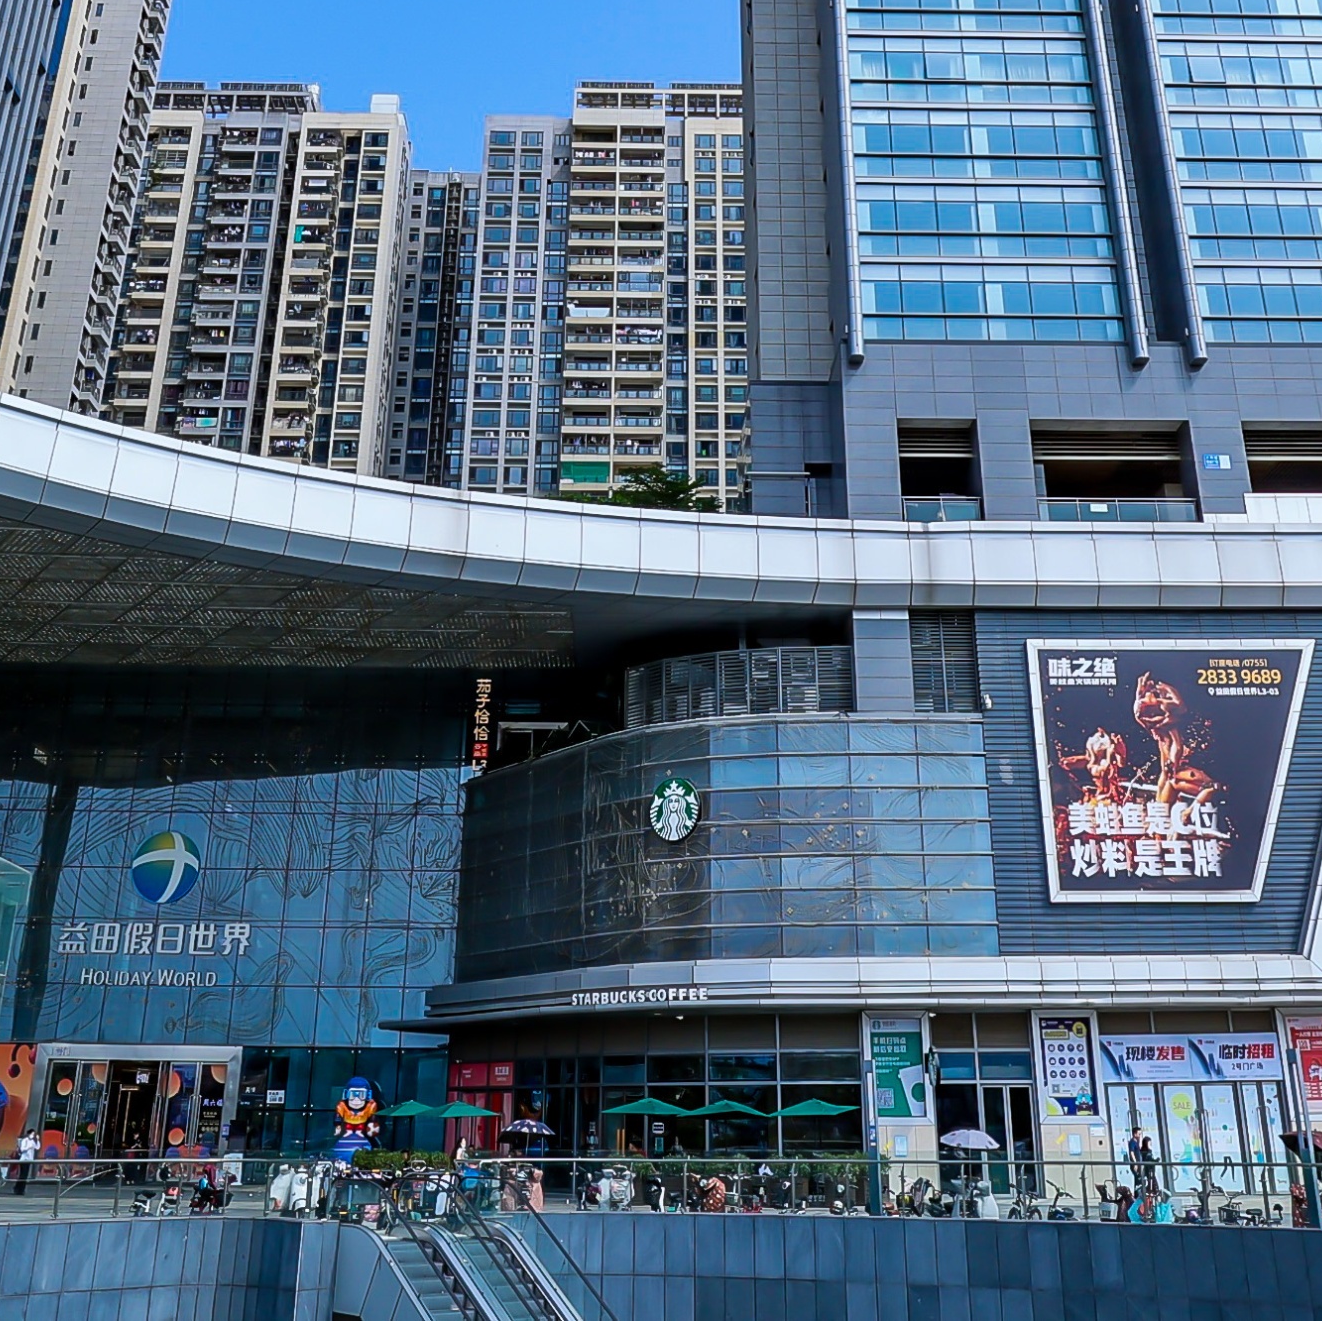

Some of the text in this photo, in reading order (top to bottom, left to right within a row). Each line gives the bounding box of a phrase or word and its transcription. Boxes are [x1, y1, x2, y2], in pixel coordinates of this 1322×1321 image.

[1048, 657, 1117, 677] 味之绝
[1197, 669, 1282, 684] 2833 9689
[1071, 839, 1223, 877] 炒料是王牌
[58, 922, 251, 955] 益田假日世界
[572, 988, 708, 1006] STARBUCKS COFFEE
[1126, 1046, 1185, 1061] 现楼发售
[1219, 1043, 1275, 1060] 临时招租
[1173, 1102, 1191, 1110] SALE
